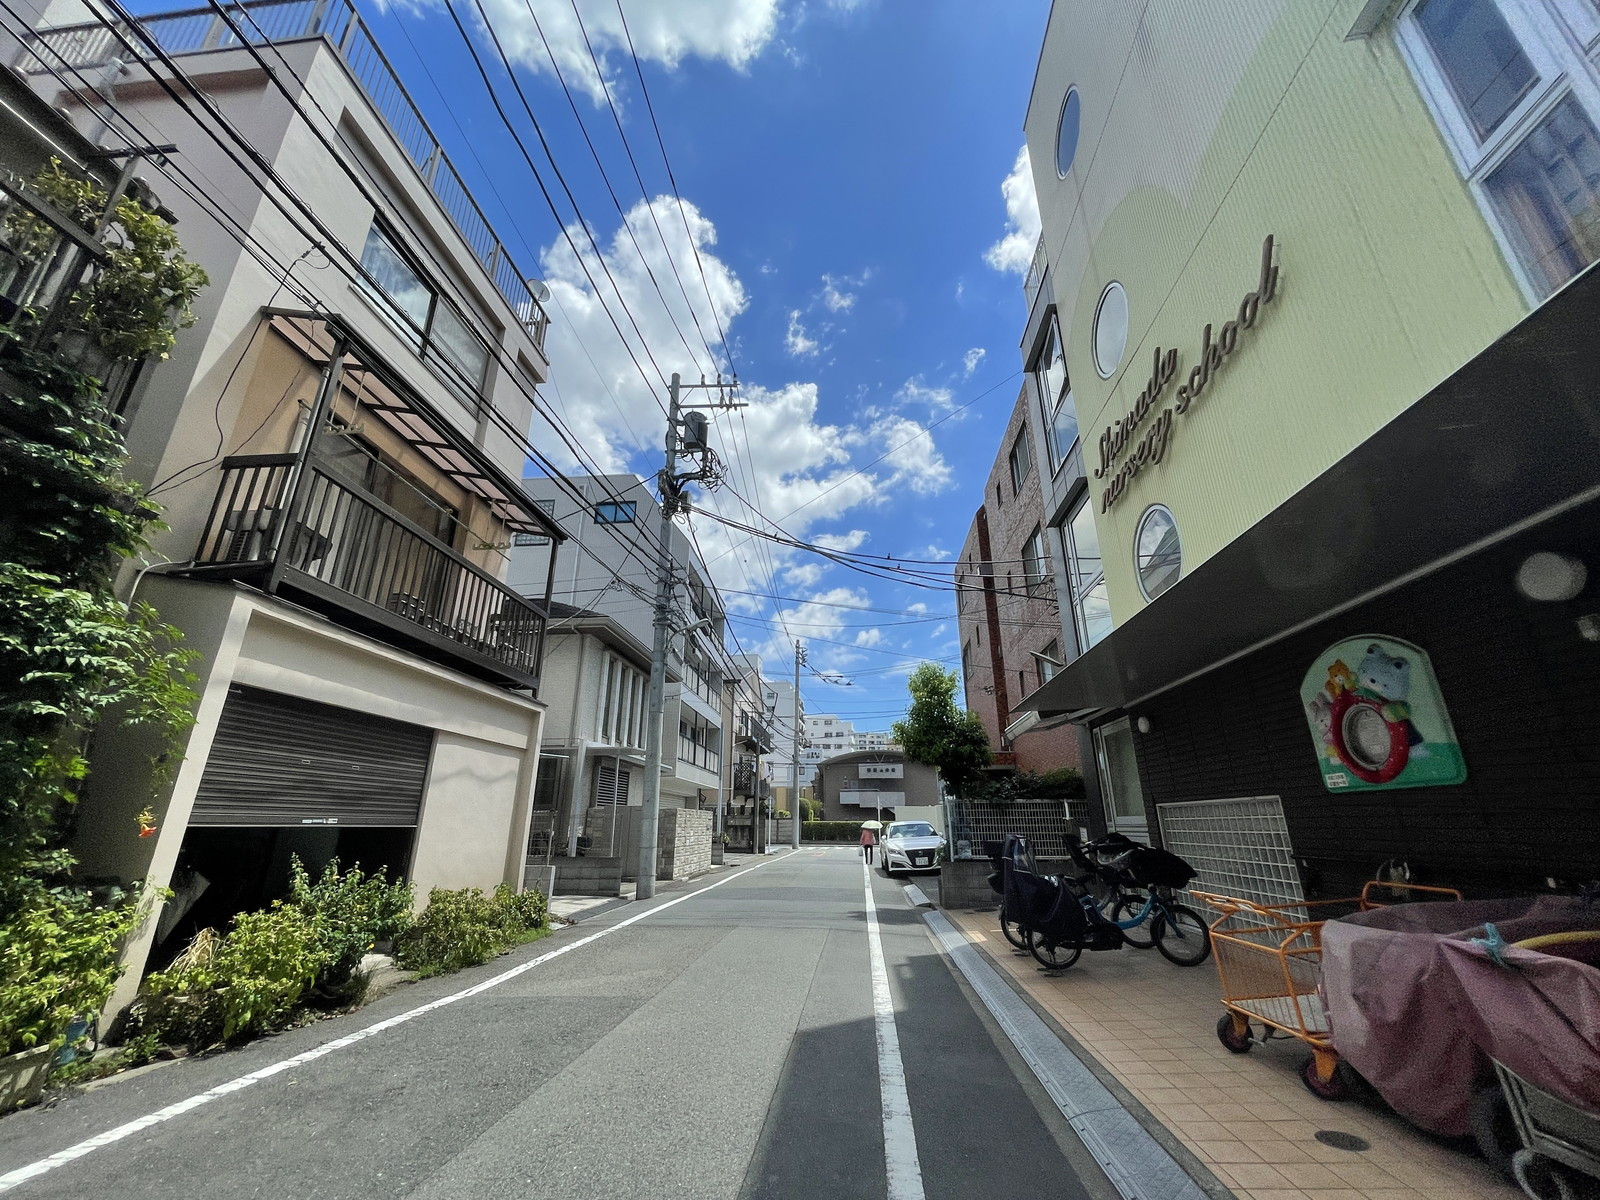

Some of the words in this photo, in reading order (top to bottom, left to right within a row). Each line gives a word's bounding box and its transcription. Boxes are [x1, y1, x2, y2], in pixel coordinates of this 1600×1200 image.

[1094, 346, 1178, 479] Shimada
[1101, 408, 1173, 514] nursery
[1175, 234, 1279, 415] school
